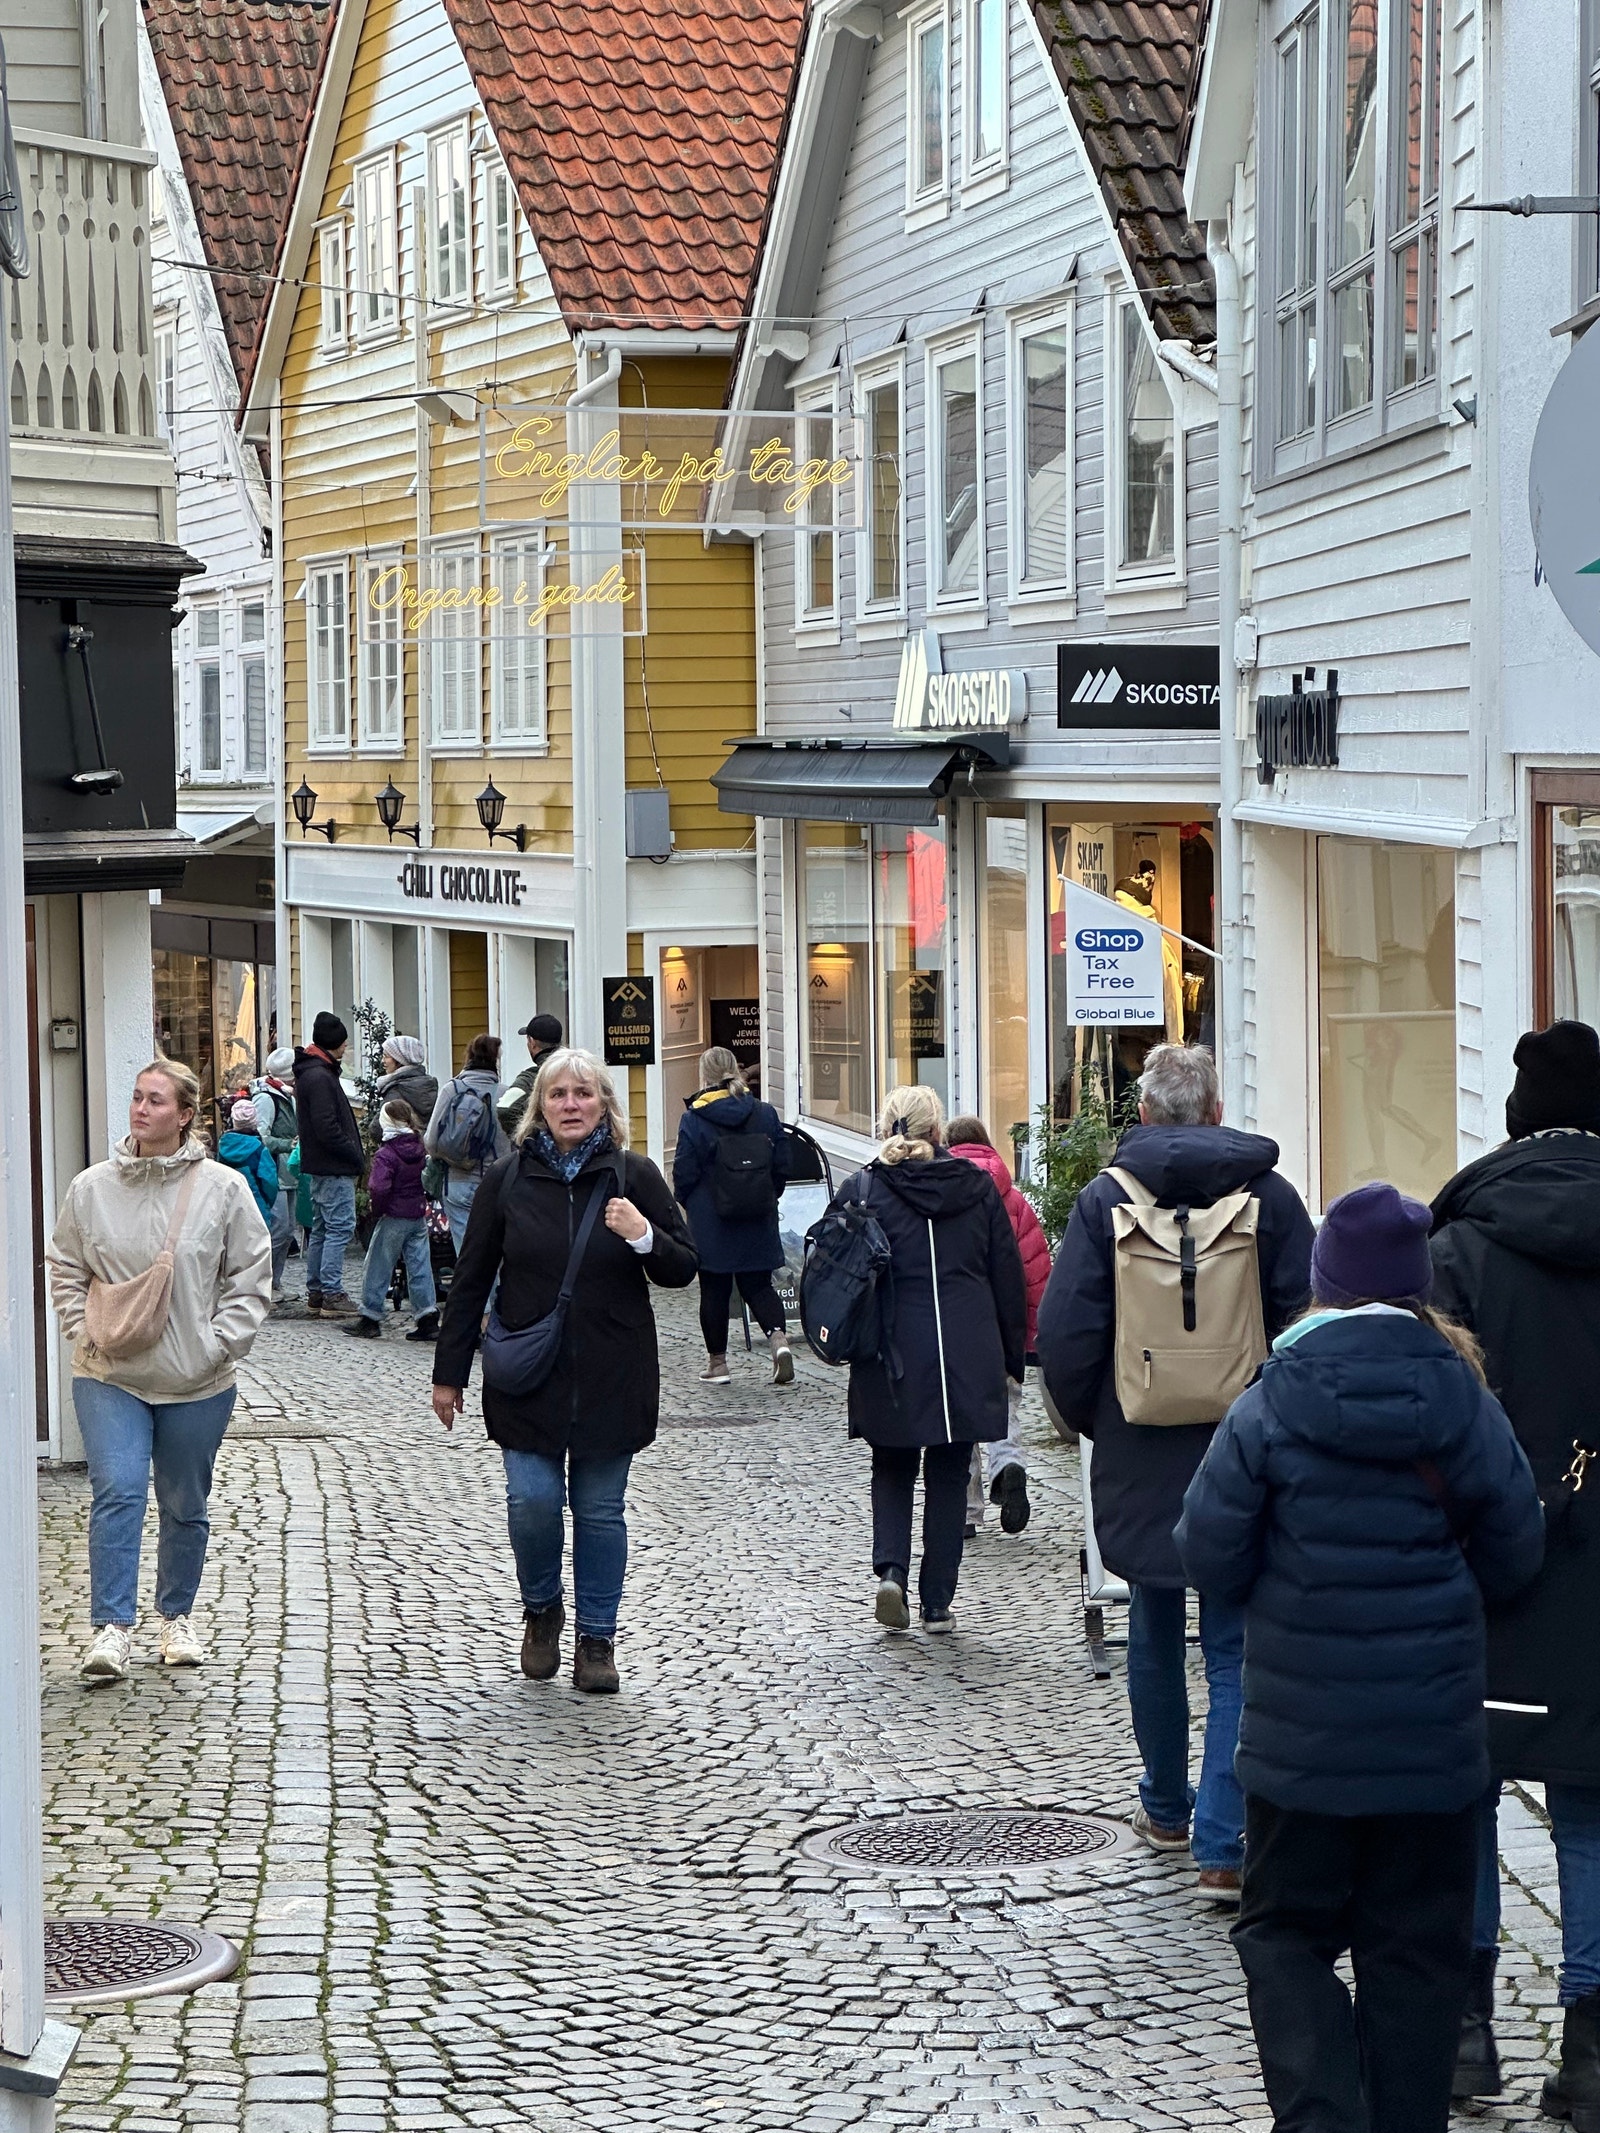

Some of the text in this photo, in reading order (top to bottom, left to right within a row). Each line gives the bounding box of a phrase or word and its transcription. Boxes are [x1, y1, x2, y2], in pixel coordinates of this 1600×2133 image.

[495, 417, 853, 516] Englar på tage
[513, 580, 529, 605] i
[528, 564, 635, 627] gadå
[928, 671, 1011, 727] SKOGSTAD
[1126, 683, 1220, 705] SKOGSTA
[1077, 841, 1104, 871] SKAPT
[1081, 930, 1139, 951] Shop
[1082, 955, 1119, 970] Tax
[1087, 974, 1135, 989] Free
[1075, 1008, 1156, 1019] Global Blue
[742, 1018, 753, 1026] TO
[608, 1025, 651, 1035] GULLSMED
[736, 1029, 760, 1037] JEWEL
[609, 1036, 650, 1046] VERKSTED
[732, 1038, 761, 1047] WORKS
